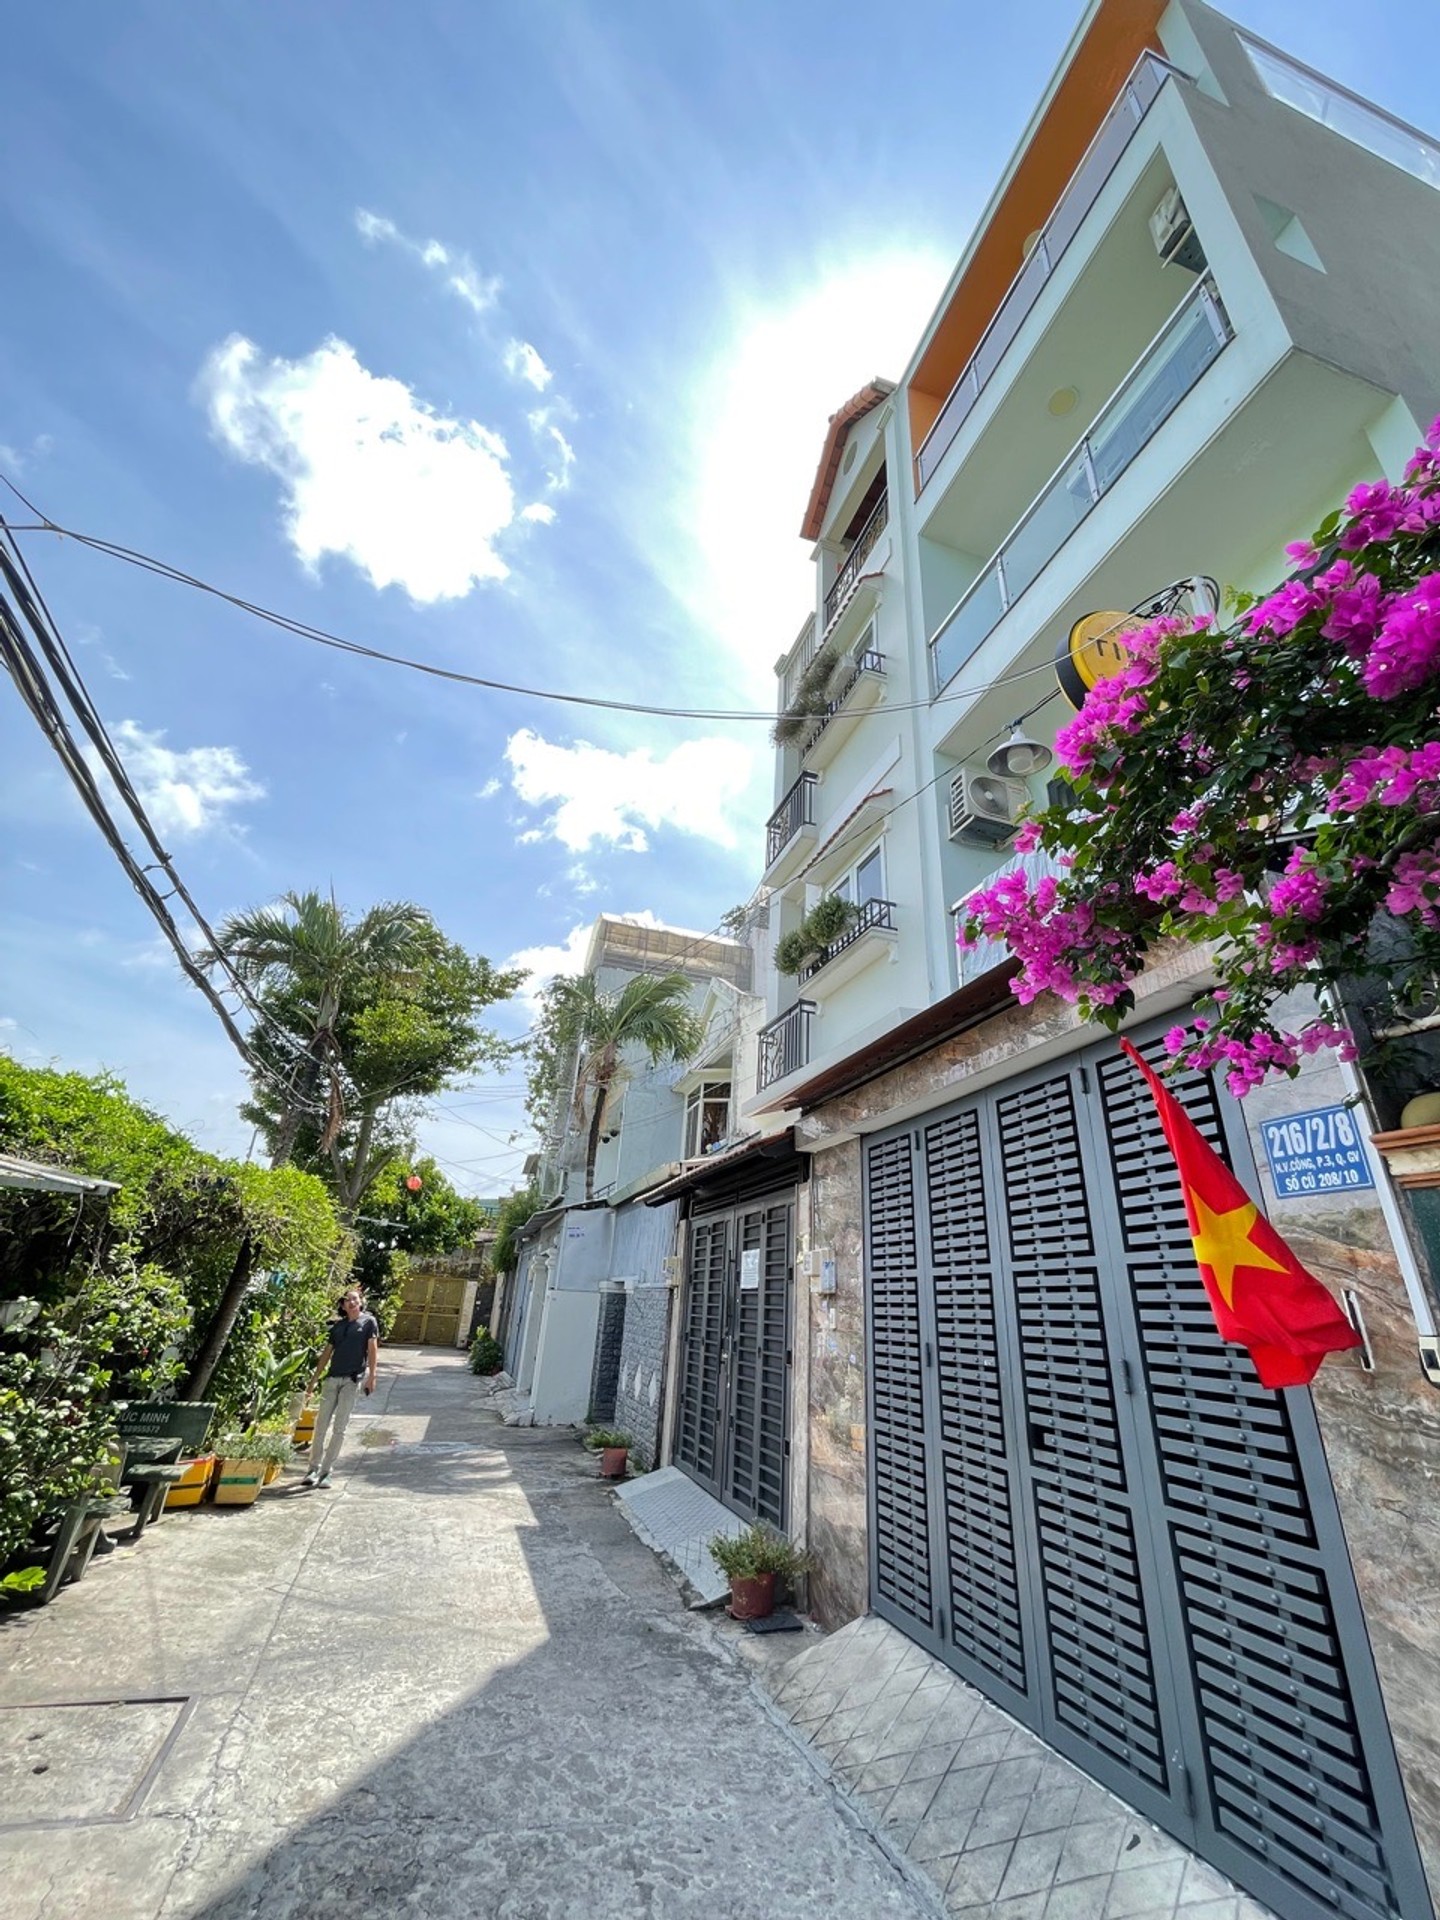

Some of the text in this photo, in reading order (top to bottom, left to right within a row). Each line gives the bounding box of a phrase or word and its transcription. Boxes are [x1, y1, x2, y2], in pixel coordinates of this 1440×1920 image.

[1267, 1111, 1355, 1158] 216/2/8
[1347, 1150, 1360, 1163] GV
[1285, 1173, 1300, 1191] SỐ
[1301, 1172, 1316, 1188] CŨ
[140, 1412, 171, 1423] MINH
